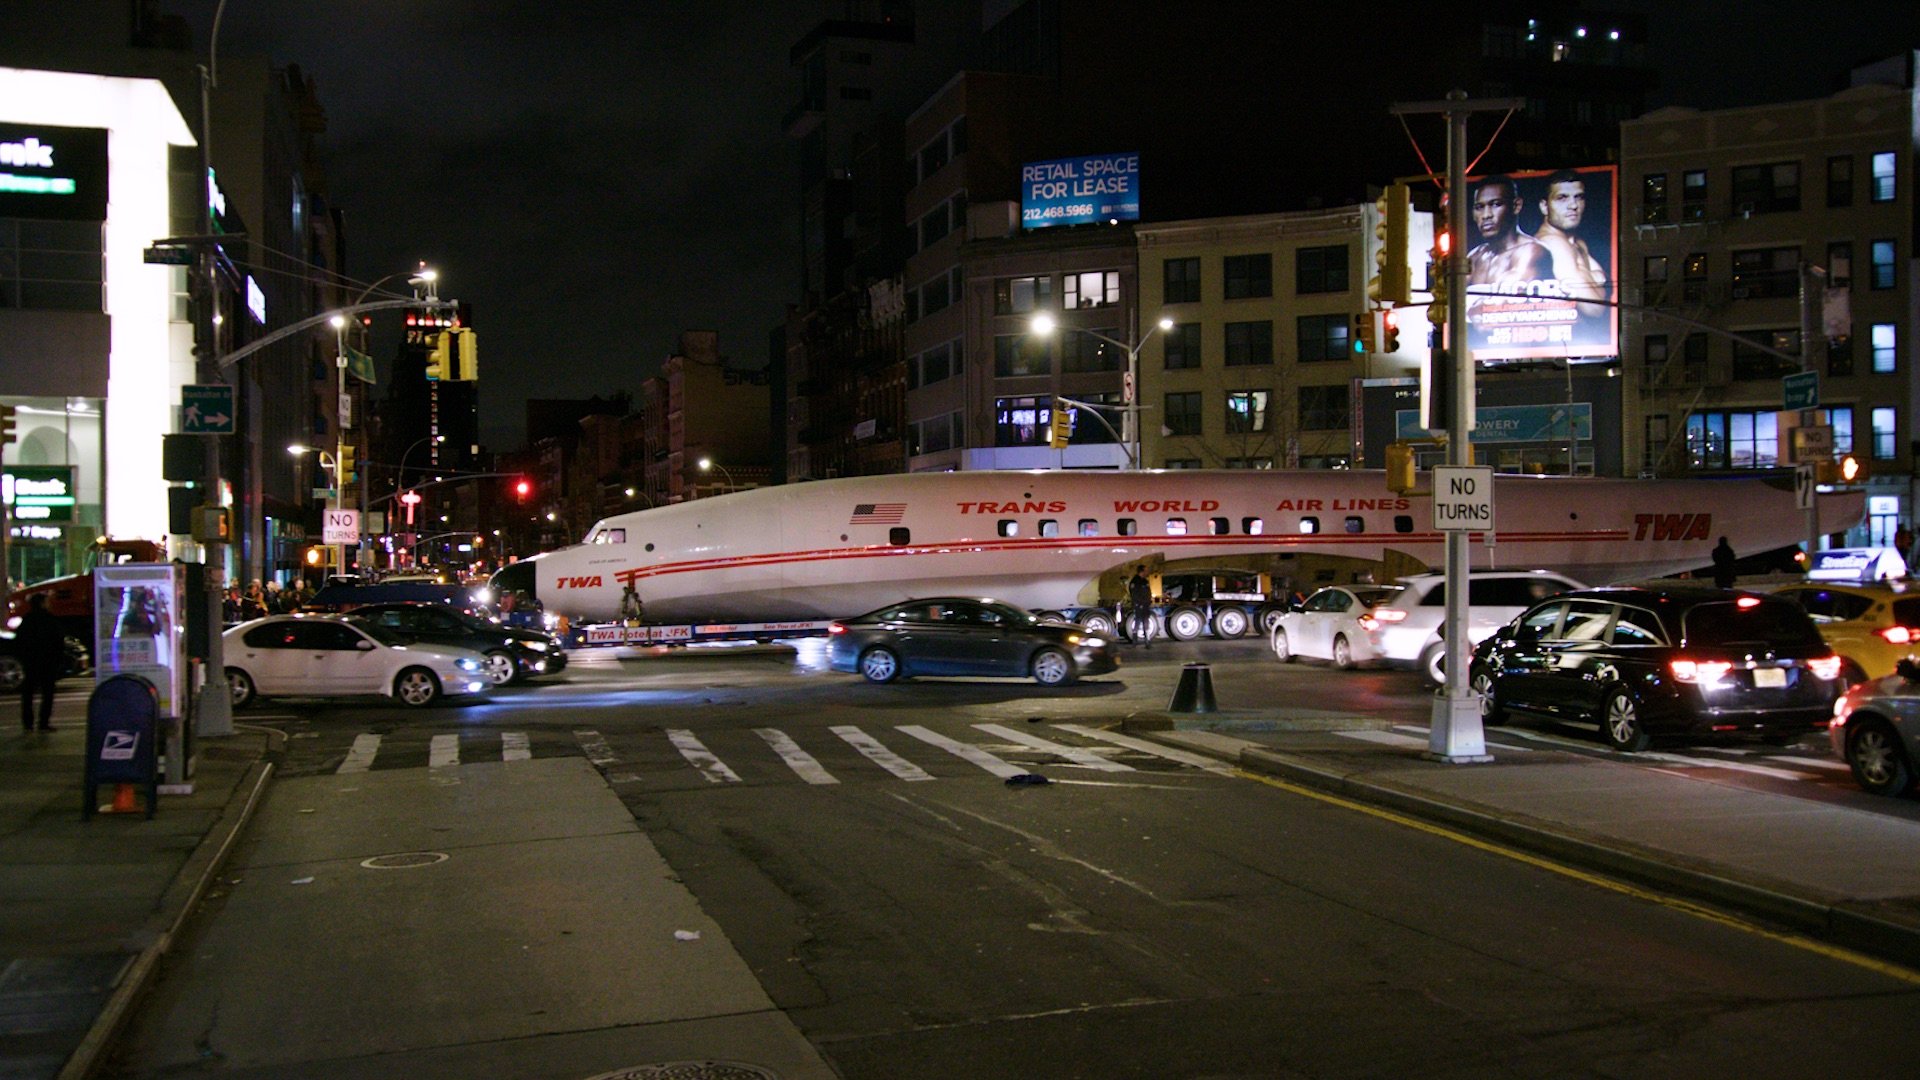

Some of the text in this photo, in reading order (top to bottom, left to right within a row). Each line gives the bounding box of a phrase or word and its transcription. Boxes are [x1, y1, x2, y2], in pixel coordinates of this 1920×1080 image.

[1023, 156, 1139, 182] RETAIL SPACE
[1032, 176, 1129, 200] FOR LEASE
[1023, 204, 1094, 220] 212.468.5966
[1475, 419, 1521, 430] OWERY
[1451, 478, 1476, 495] NO
[956, 498, 1411, 515] TRANS WORLD AIR LINES
[1437, 503, 1490, 520] TURNS
[329, 514, 354, 527] NO
[1634, 513, 1712, 541] TWA
[325, 530, 357, 541] TURNS
[556, 576, 603, 589] TWA
[591, 627, 689, 640] TWA Hotel at JFK
